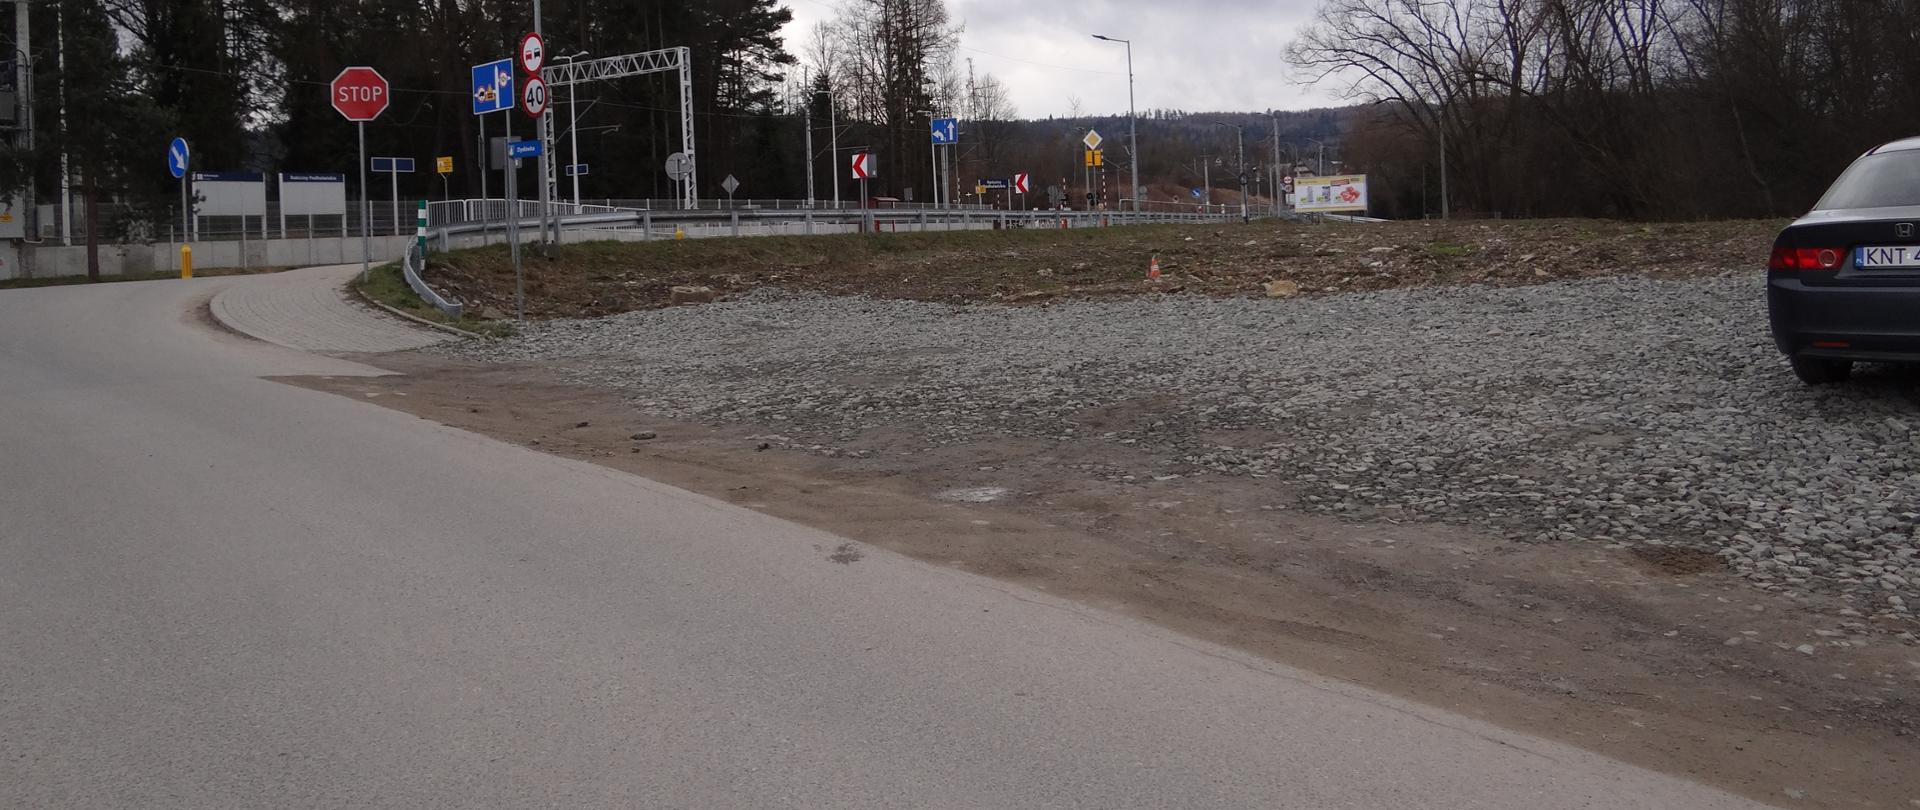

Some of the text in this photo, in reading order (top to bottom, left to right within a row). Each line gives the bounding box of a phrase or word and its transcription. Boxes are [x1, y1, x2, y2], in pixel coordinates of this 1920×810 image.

[339, 86, 382, 102] STOP
[526, 86, 544, 107] 40
[1866, 247, 1906, 265] KNT
